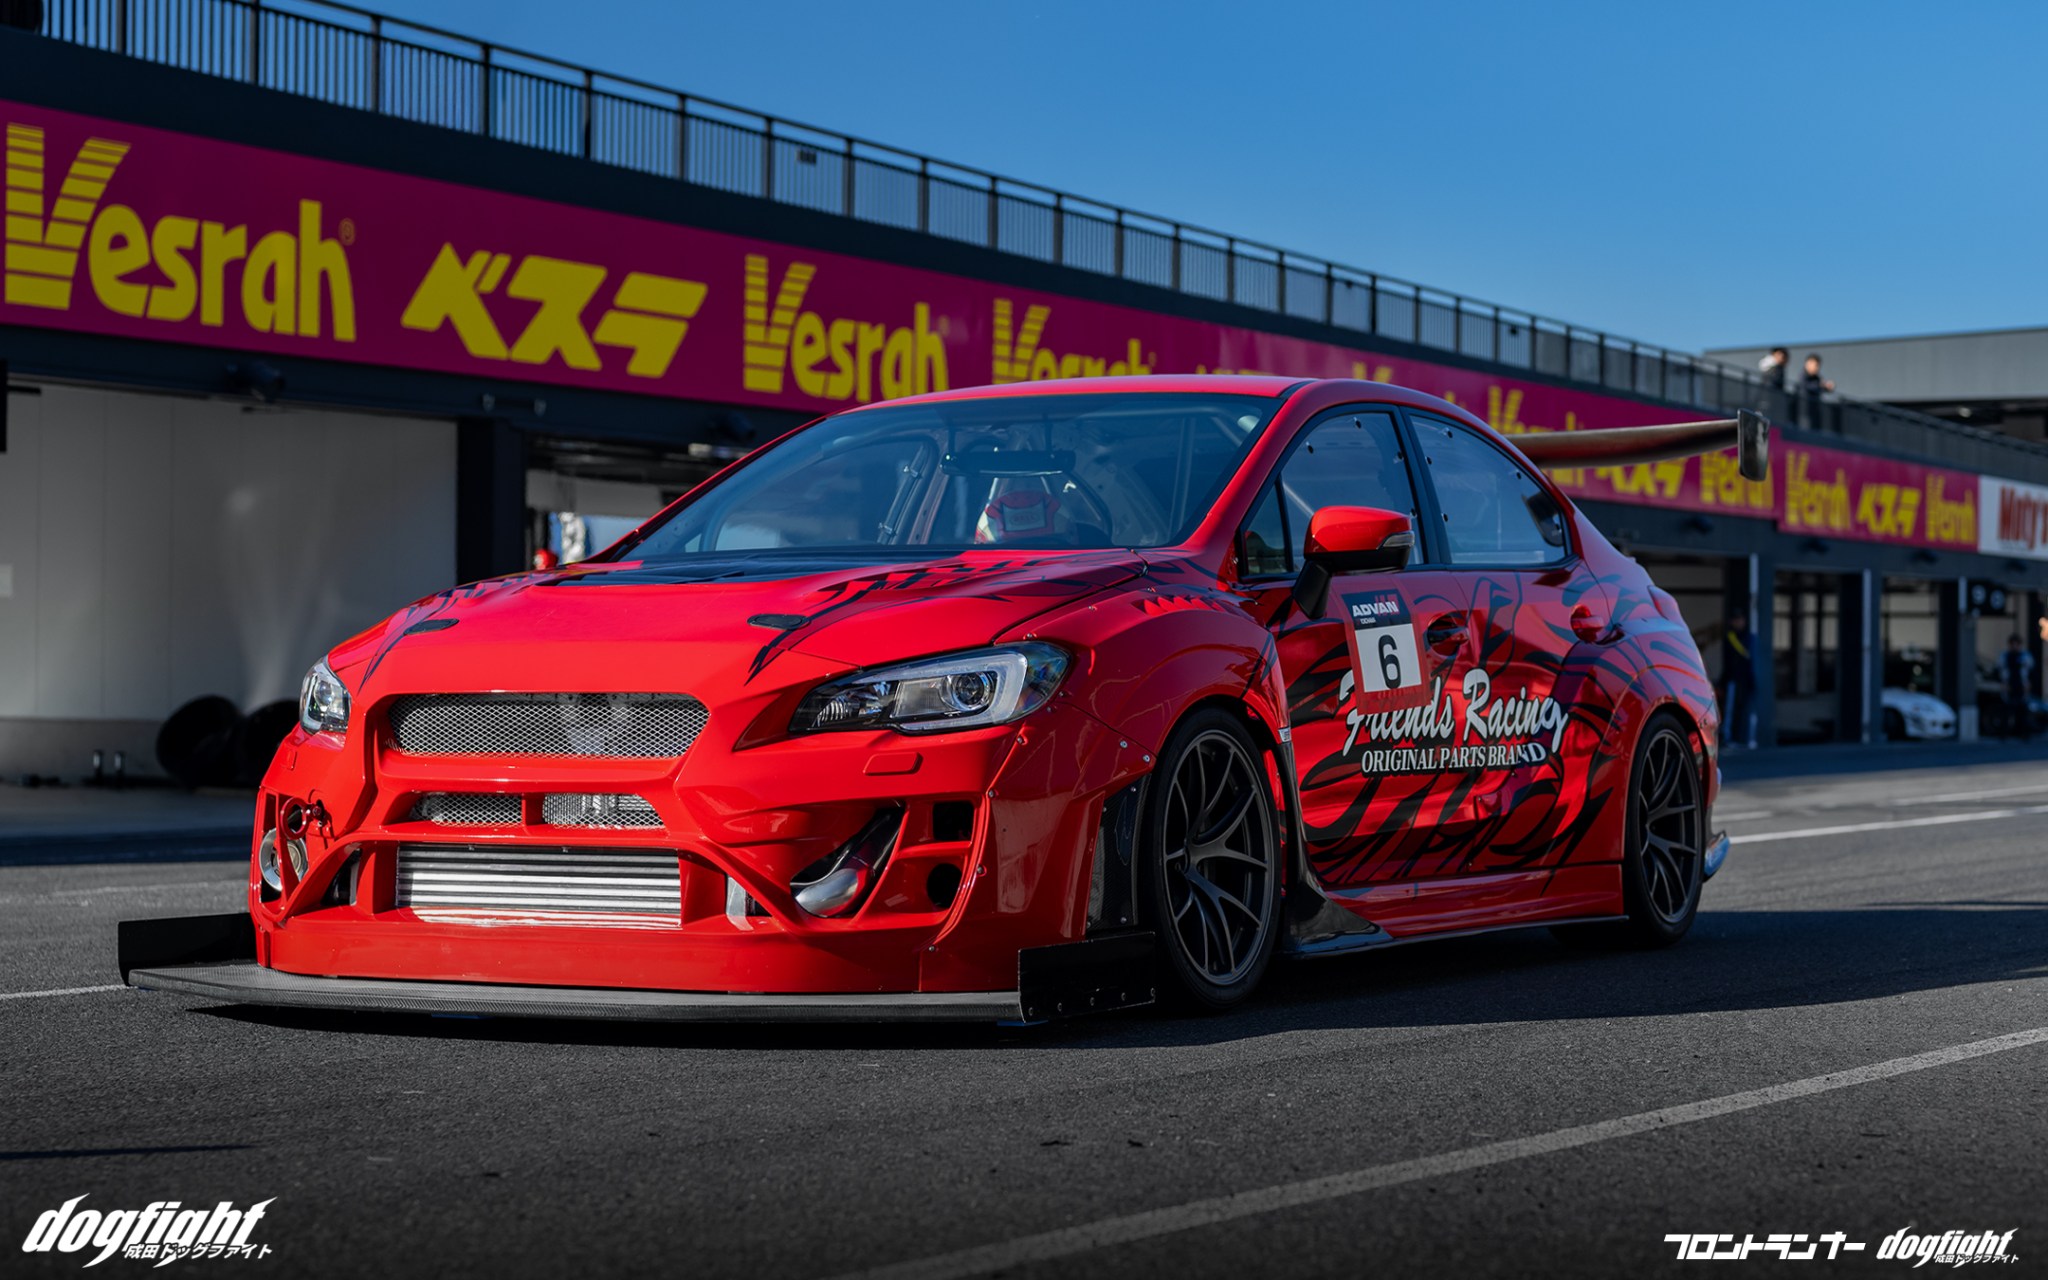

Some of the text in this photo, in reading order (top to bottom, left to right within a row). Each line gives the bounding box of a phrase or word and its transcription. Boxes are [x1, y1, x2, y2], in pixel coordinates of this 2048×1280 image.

[4, 121, 356, 343] Vesrah
[400, 242, 708, 378] ベスラ
[743, 254, 949, 402] Vesrah
[1856, 482, 1921, 538] ベスラ
[1352, 601, 1399, 617] ADVAN
[1378, 634, 1402, 690] 6
[1463, 668, 1569, 754] Racing
[1361, 742, 1546, 773] ORIGINAL PARTS BRAND
